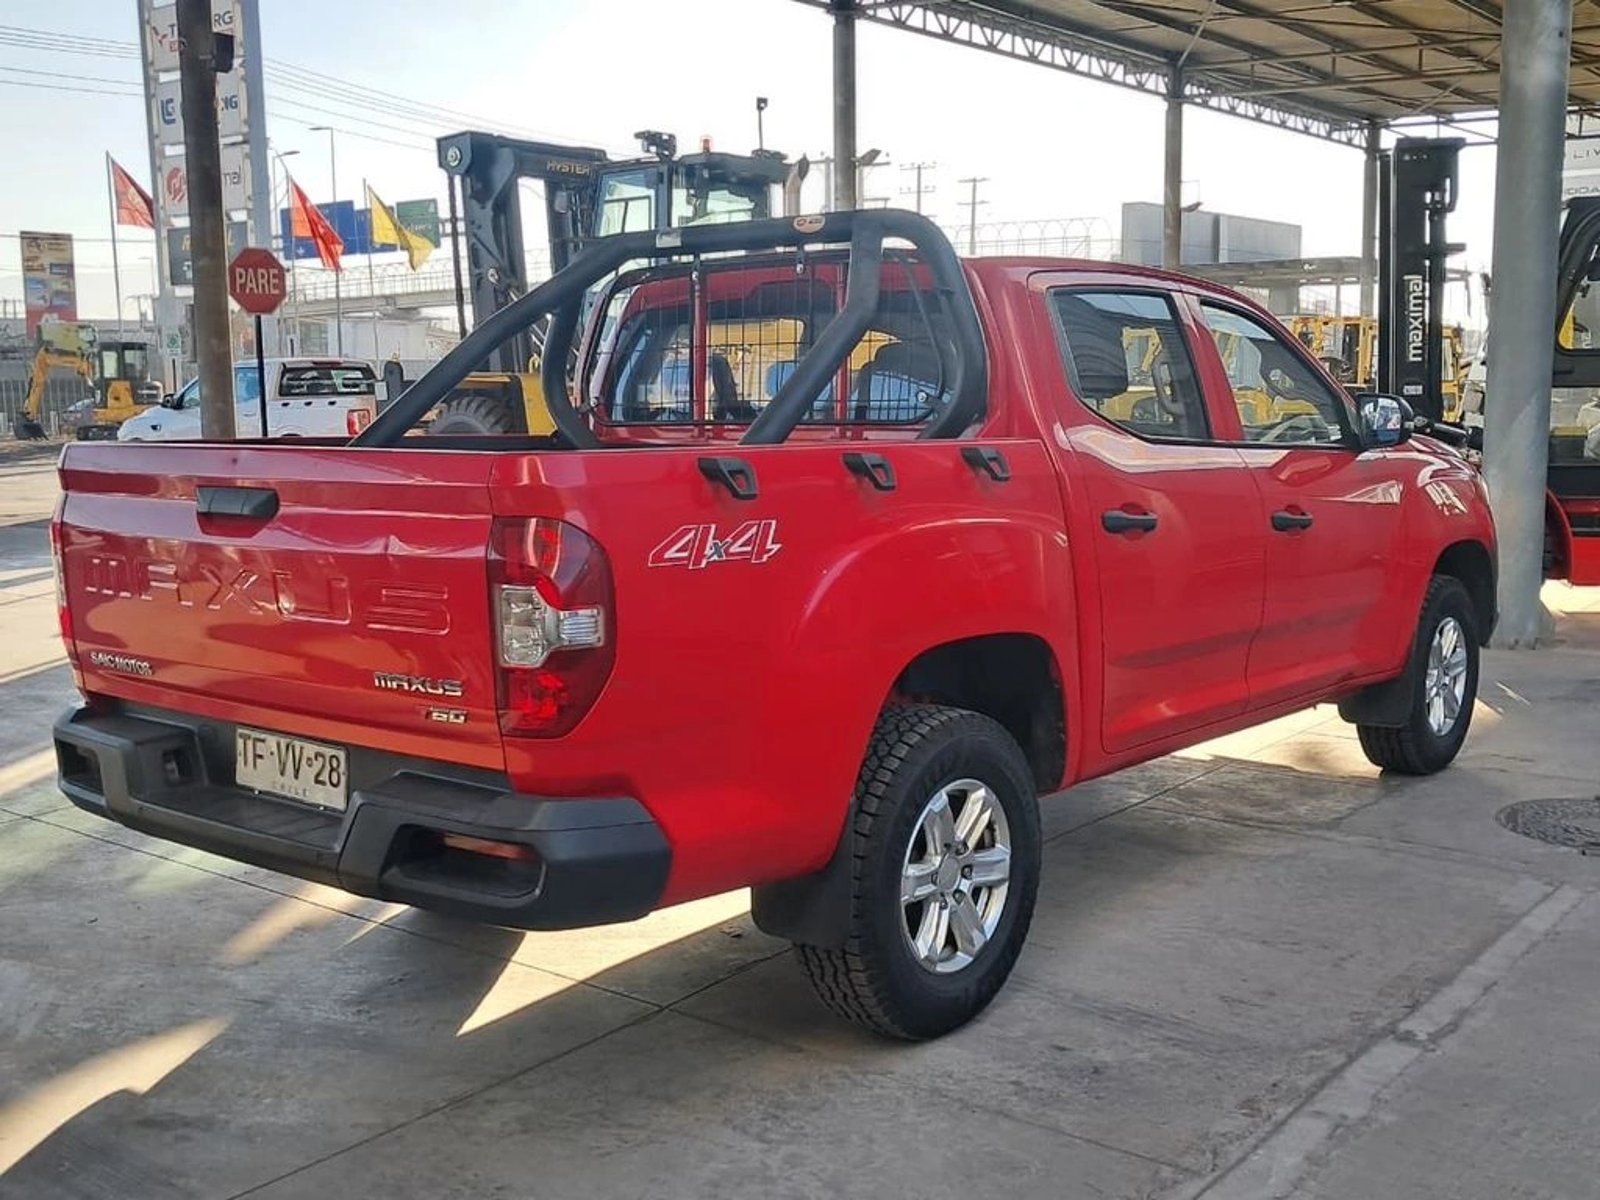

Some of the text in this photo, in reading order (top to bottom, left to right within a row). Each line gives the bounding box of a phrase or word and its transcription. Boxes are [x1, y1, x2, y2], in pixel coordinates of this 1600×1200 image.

[235, 267, 280, 294] PARE
[1403, 274, 1423, 362] maximal
[84, 553, 451, 636] MAXUS
[374, 672, 463, 697] MAXUS
